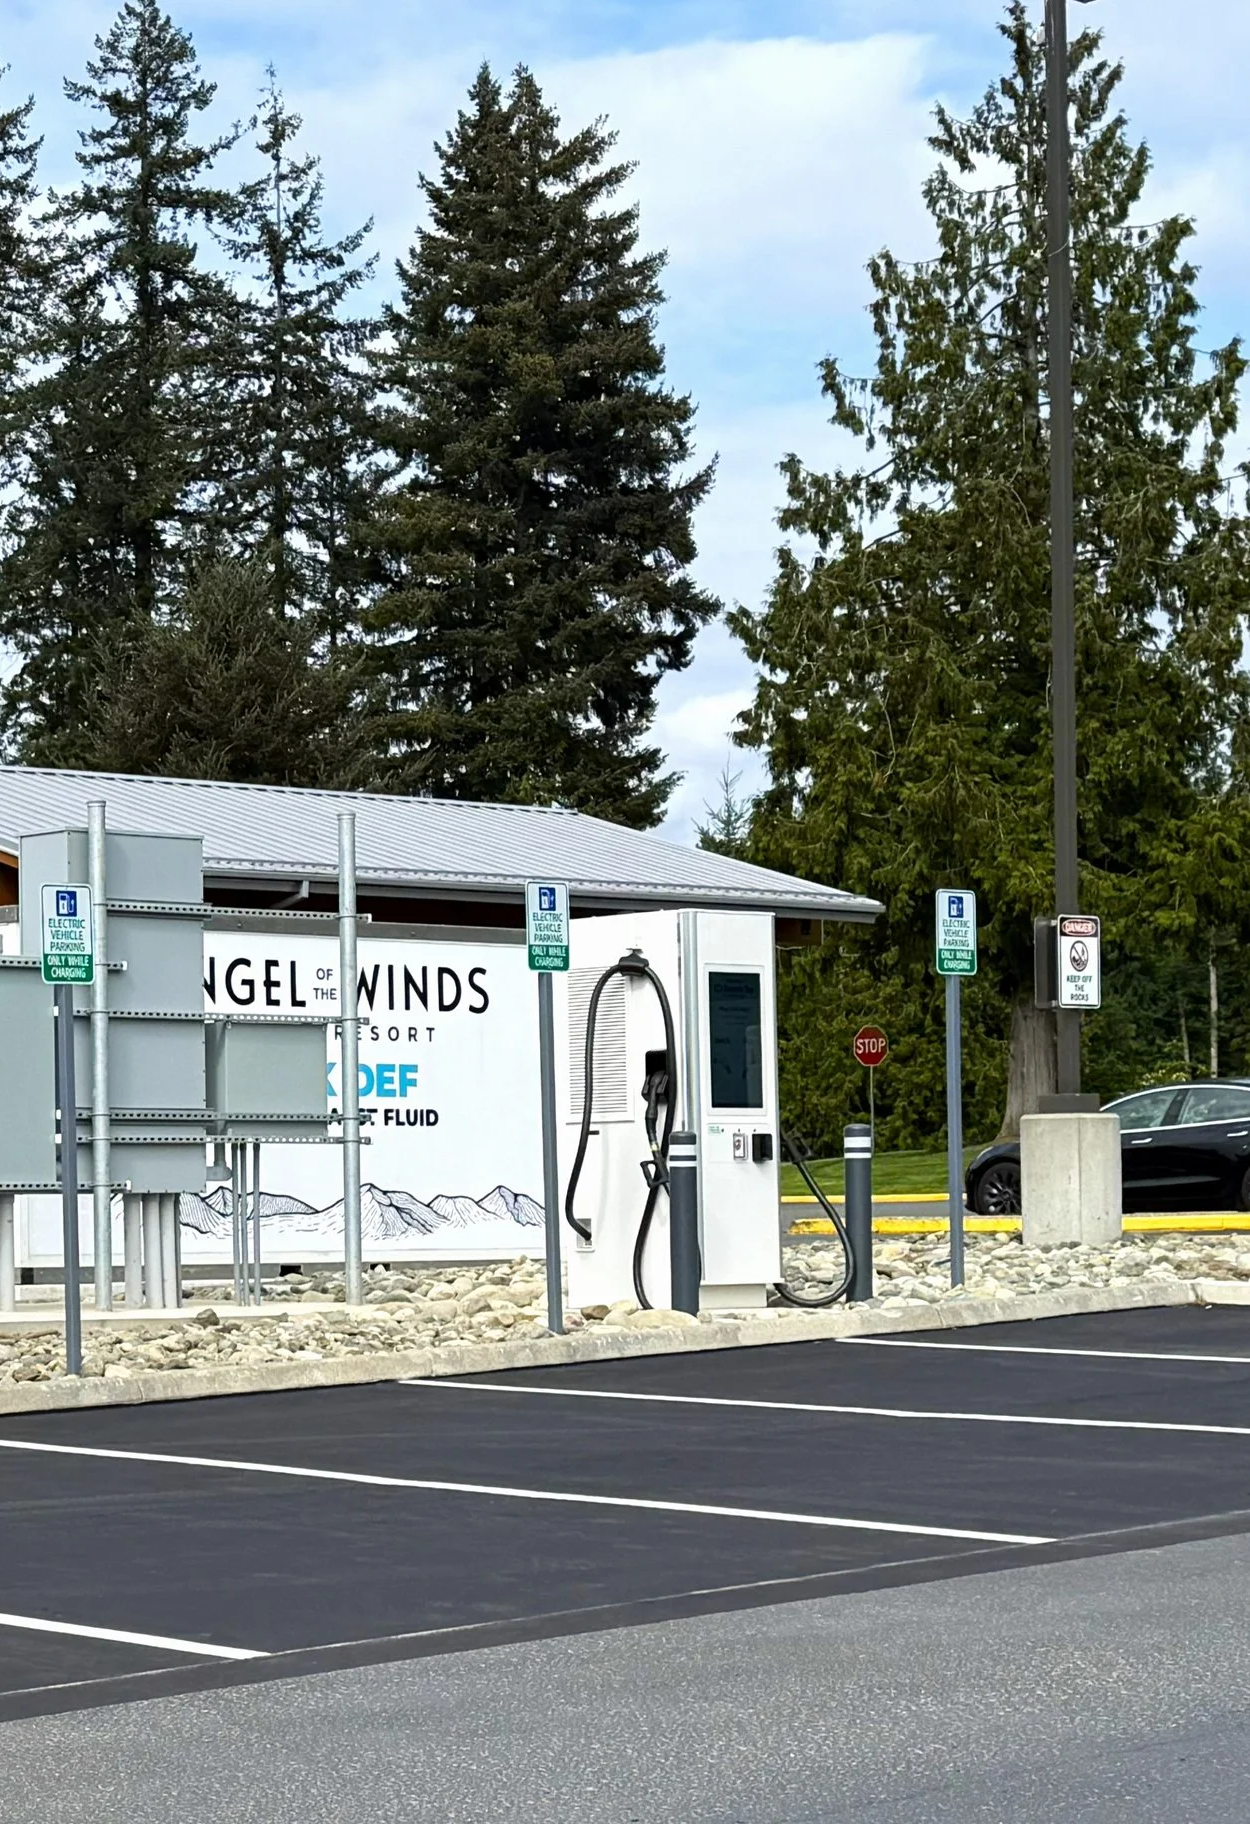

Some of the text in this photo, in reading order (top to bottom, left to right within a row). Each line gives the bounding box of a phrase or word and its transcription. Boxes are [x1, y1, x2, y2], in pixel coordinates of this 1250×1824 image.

[533, 912, 563, 922] ELECTRIC
[48, 918, 86, 929] ELECTRIC
[535, 923, 562, 933] VEHICLE
[942, 919, 970, 928] ELECTRIC
[1065, 922, 1093, 933] DANGER
[50, 930, 84, 940] VEHICLE
[534, 933, 563, 943] PARKING
[944, 929, 969, 938] VEHICLE
[50, 941, 85, 952] PARKING
[943, 938, 970, 948] PARKING
[531, 946, 566, 957] ONLY WHILE
[941, 950, 972, 960] ONLY WHILE
[47, 955, 89, 967] ONLY WHILE
[534, 957, 564, 967] CHARGING
[943, 960, 970, 970] CHARGING
[51, 967, 86, 978] CHARGING
[1066, 975, 1093, 983] KEEP OFF
[203, 957, 490, 1014] NGEL OF WINDS
[1074, 984, 1085, 992] THE
[313, 988, 338, 1001] THE
[1070, 993, 1089, 1002] ROCKS
[856, 1038, 886, 1054] STOP
[358, 1063, 418, 1098] DEF
[383, 1108, 439, 1127] FLUID
